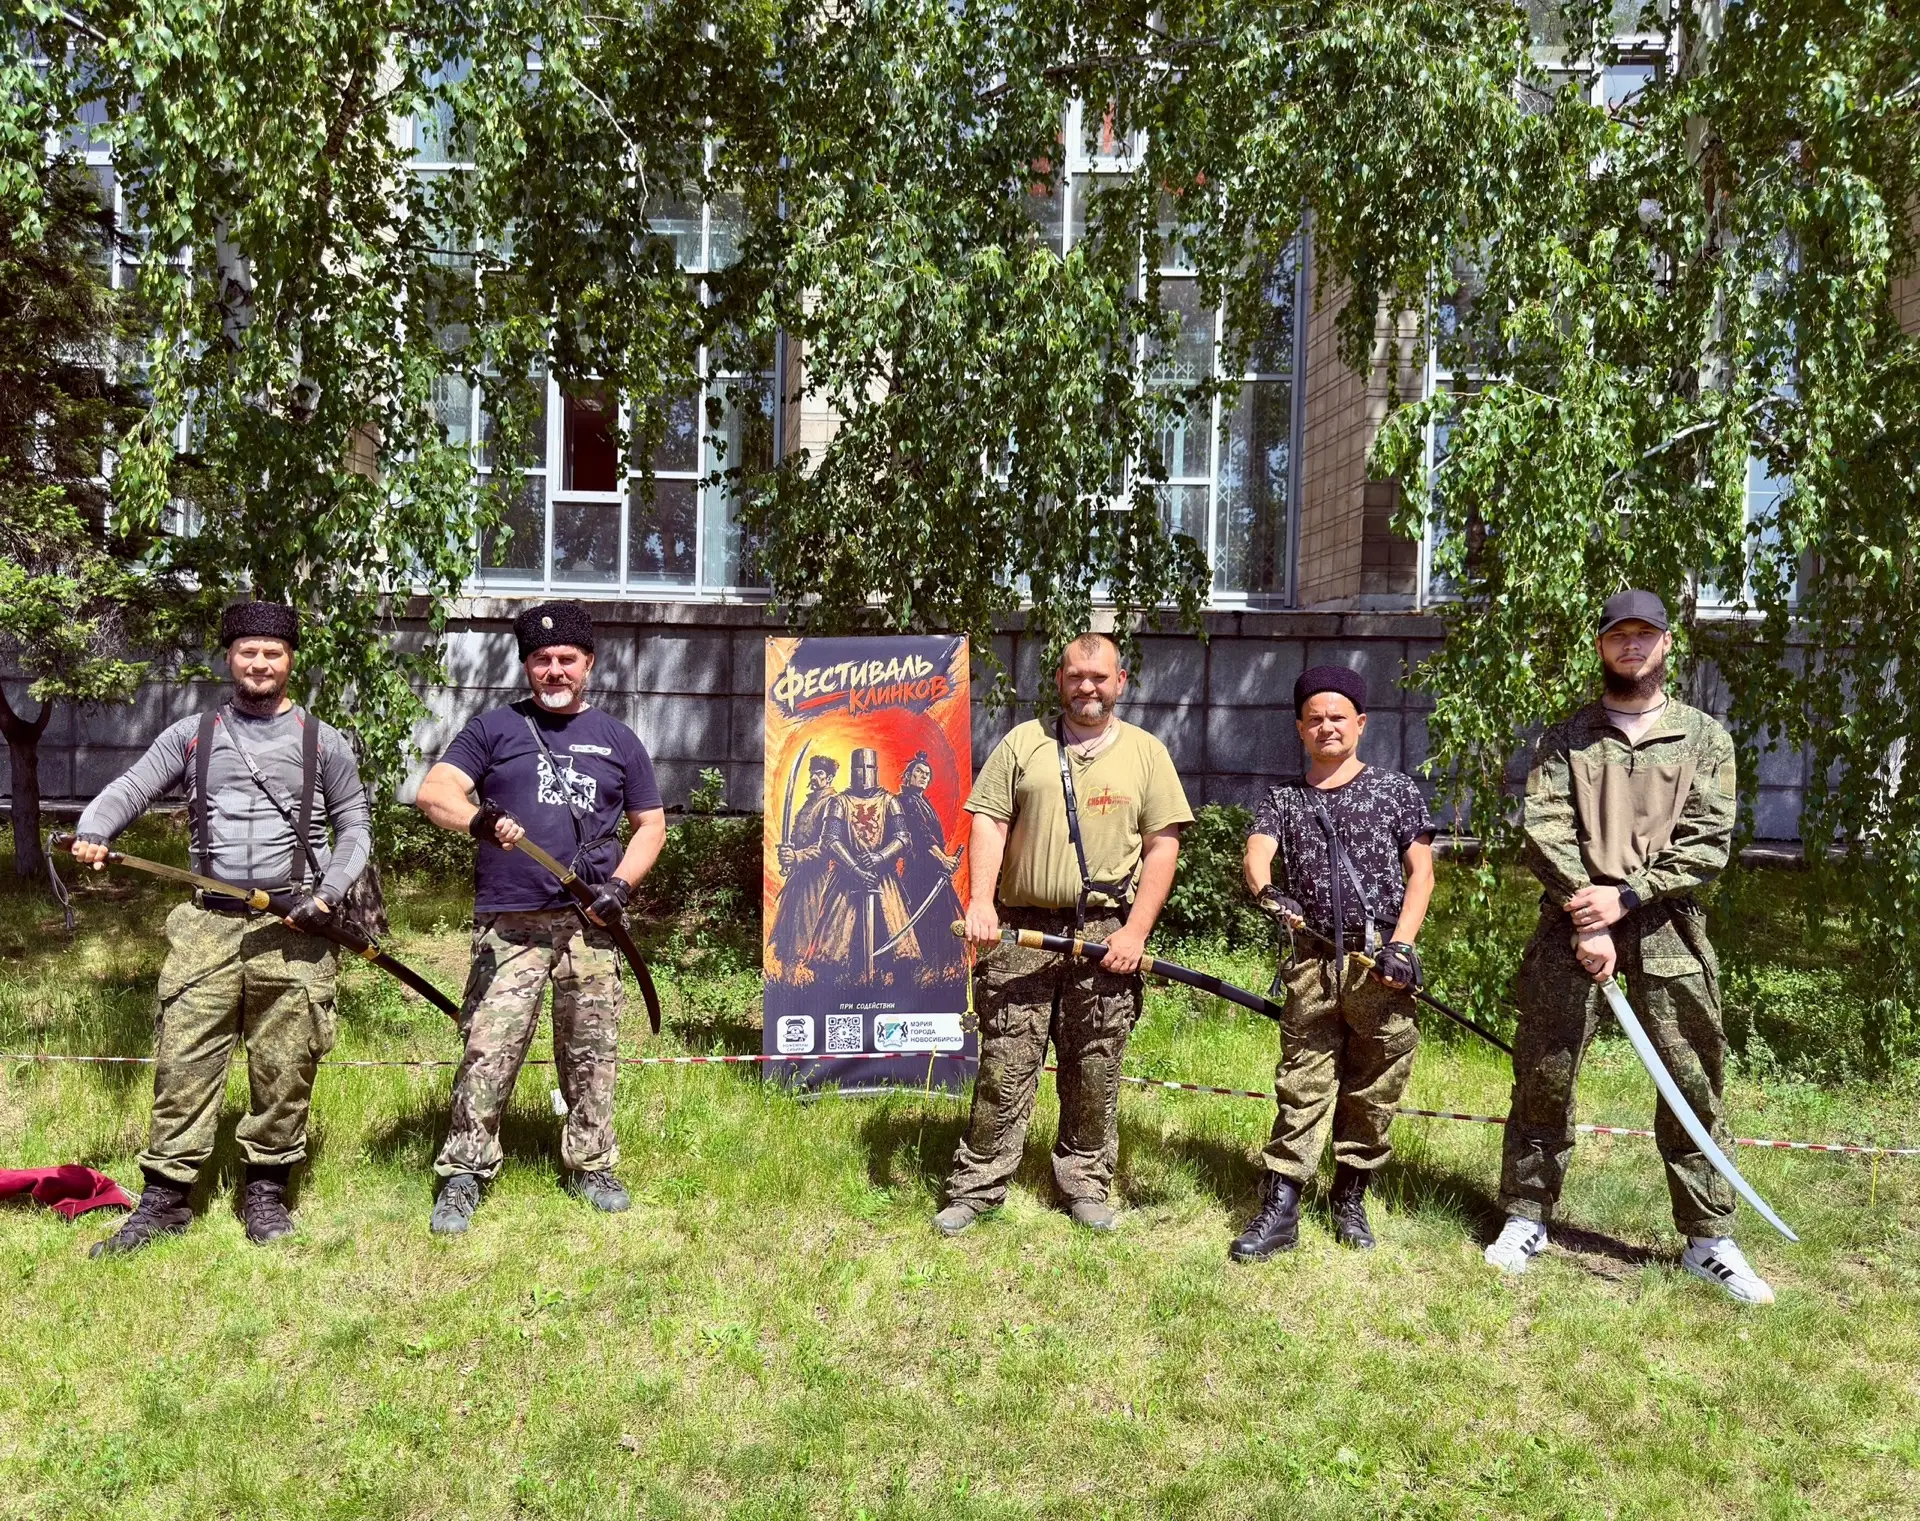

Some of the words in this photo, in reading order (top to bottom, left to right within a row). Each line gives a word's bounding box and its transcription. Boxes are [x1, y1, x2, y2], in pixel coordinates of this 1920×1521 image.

[773, 654, 934, 712] ФЕСТИВАЛЬ
[849, 675, 950, 714] КЛИНКОВ
[856, 1001, 896, 1010] СОДЕЙСТВИИ
